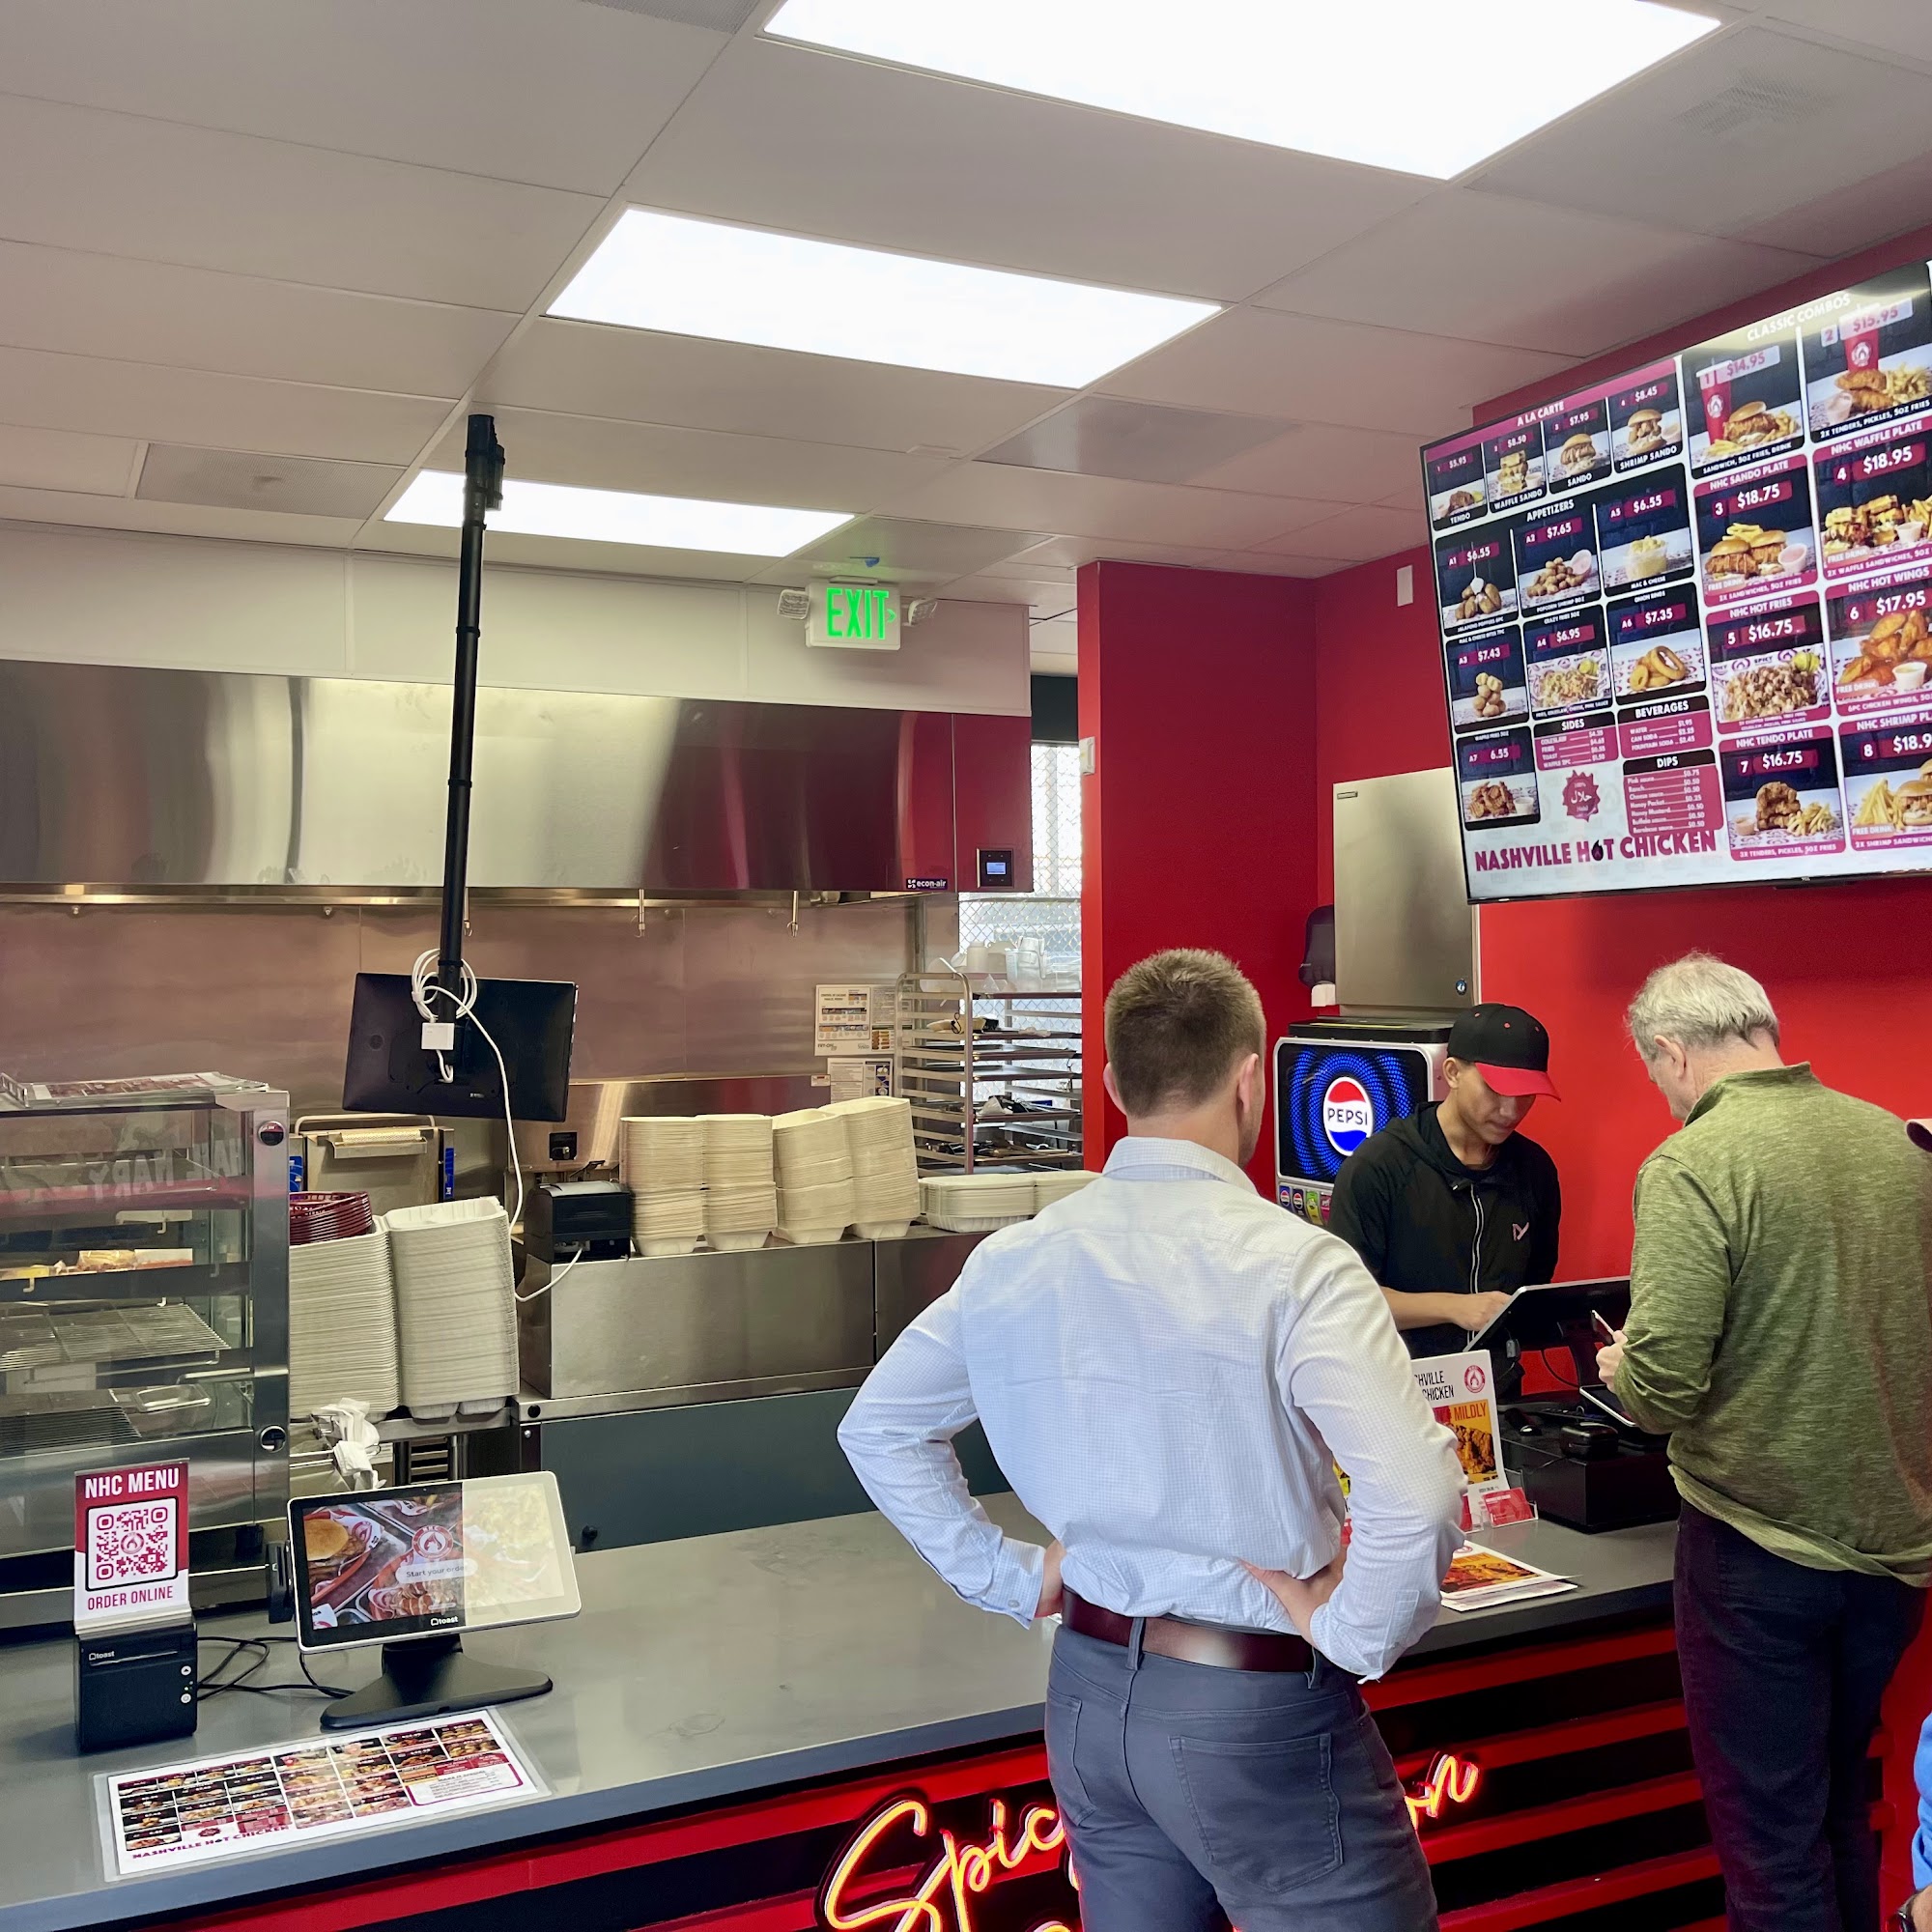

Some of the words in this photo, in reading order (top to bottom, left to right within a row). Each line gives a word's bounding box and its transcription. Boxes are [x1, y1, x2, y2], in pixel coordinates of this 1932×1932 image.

[1747, 315, 1795, 342] CLASSIC
[1797, 293, 1851, 323] COMBOS
[1825, 329, 1833, 341] 2
[1853, 306, 1898, 332] $15.95
[1705, 374, 1710, 384] 1
[1727, 353, 1765, 377] $14.95
[1634, 386, 1658, 402] $8.45
[1517, 416, 1524, 426] A
[1525, 413, 1536, 422] LA
[1538, 401, 1564, 418] CARTE
[1569, 412, 1589, 426] $7.95
[1863, 412, 1893, 425] PICKLES,
[1911, 400, 1930, 411] FRIES
[1507, 435, 1526, 448] $8.50
[1831, 441, 1853, 455] NHC
[1854, 430, 1890, 448] WAFFLE
[1892, 420, 1922, 437] PLATE
[1619, 455, 1648, 470] SHRIMP
[1650, 445, 1677, 460] SANDO
[1702, 460, 1737, 473] SANDWICH,
[1837, 467, 1847, 480] 4
[1862, 445, 1913, 474] $18.95
[1567, 472, 1592, 487] SANDO
[1710, 477, 1728, 491] NHC
[1729, 469, 1761, 485] SANDO
[1762, 459, 1789, 475] PLATE
[1493, 497, 1519, 510] WAFFLE
[1520, 489, 1543, 501] SANDO
[1633, 495, 1662, 514] $6.55
[1715, 502, 1723, 516] 3
[1737, 483, 1780, 509] $18.75
[1450, 512, 1470, 524] TENDO
[1526, 499, 1575, 522] APPETIZERS
[1526, 533, 1536, 543] A2
[1547, 522, 1572, 539] $7.65
[1449, 557, 1457, 566] A1
[1466, 547, 1491, 562] $6.55
[1828, 555, 1843, 564] FREE
[1845, 550, 1868, 558] DRINK
[1838, 564, 1864, 575] WAFFLE
[1865, 553, 1913, 569] SANDWICHES,
[1648, 576, 1665, 585] CHEESE
[1708, 582, 1722, 591] FREE
[1848, 581, 1869, 592] NHC
[1871, 575, 1891, 587] HOT
[1893, 566, 1930, 582] WINGS
[1634, 593, 1650, 603] ONION
[1728, 584, 1770, 600] SANDWICHES,
[1785, 578, 1802, 587] FRIES
[826, 587, 890, 640] EXIT
[1536, 603, 1557, 612] POPCORN
[1729, 606, 1749, 619] NHC
[1749, 602, 1769, 614] HOT
[1770, 597, 1793, 610] FRIES
[1849, 607, 1859, 619] 6
[1876, 590, 1926, 615] $17.95
[1544, 615, 1558, 625] CRAZY
[1622, 619, 1633, 629] A6
[1645, 608, 1673, 625] $7.35
[1537, 639, 1547, 647] A4
[1556, 628, 1580, 643] $6.95
[1727, 632, 1736, 645] 5
[1748, 618, 1793, 642] $16.75
[1459, 656, 1467, 665] A3
[1478, 647, 1501, 663] $7.43
[1836, 685, 1852, 694] FREE
[1853, 682, 1877, 692] DRINK
[1634, 700, 1690, 719] BEVERAGES
[1862, 699, 1891, 710] CHICKEN
[1893, 696, 1918, 705] WINGS,
[1561, 719, 1585, 731] SIDES
[1857, 720, 1878, 730] NHC
[1880, 714, 1917, 727] SHRIMP
[1919, 711, 1932, 723] PL
[1632, 742, 1658, 751] FOUNTAIN
[1736, 738, 1755, 749] NHC
[1756, 734, 1785, 745] TENDO
[1786, 728, 1813, 740] PLATE
[1491, 748, 1509, 760] 6.55
[1542, 753, 1558, 761] TOAST
[1863, 744, 1873, 757] 8
[1657, 756, 1678, 768] DIPS
[1740, 761, 1748, 774] 7
[1762, 751, 1803, 770] $16.75
[1571, 789, 1592, 804] حلال
[1648, 807, 1670, 815] Mustard
[1475, 842, 1572, 871] NASHVILLE
[1619, 830, 1717, 859] CHICKEN
[1866, 838, 1892, 847] SHRIMP
[1749, 849, 1776, 858] TENDERS,
[916, 879, 947, 888] econ-air
[1327, 1108, 1368, 1125] PEPSI
[1414, 1371, 1445, 1387] HVILLE
[1454, 1403, 1487, 1421] MILDLY
[85, 1474, 123, 1498] NHC
[128, 1467, 180, 1493] MENU
[427, 1568, 444, 1577] your
[88, 1594, 127, 1610] ORDER
[131, 1585, 173, 1604] ONLINE
[97, 1651, 115, 1660] toast
[132, 1842, 202, 1859] NASHVILLE
[825, 1798, 1065, 1932] Spic
